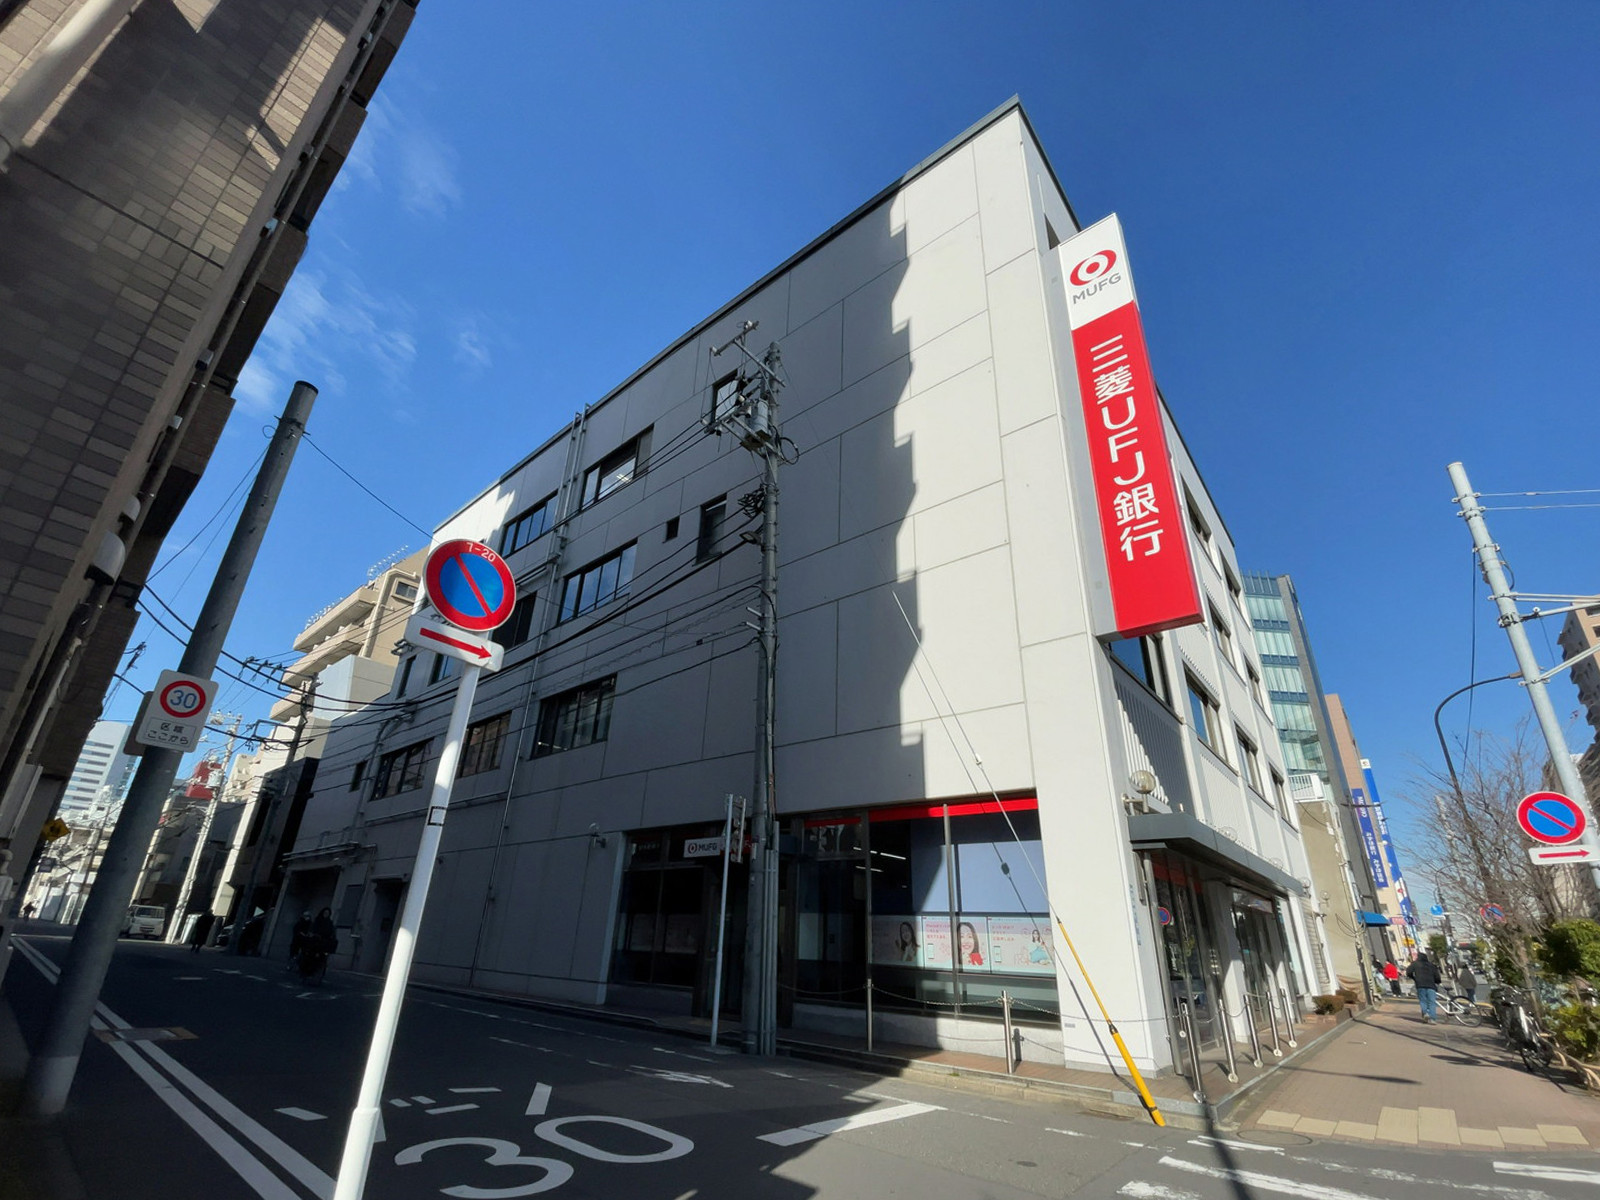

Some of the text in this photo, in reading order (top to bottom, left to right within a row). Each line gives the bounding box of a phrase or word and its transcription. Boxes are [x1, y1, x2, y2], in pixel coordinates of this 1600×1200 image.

[1072, 273, 1122, 304] MUFG
[1089, 333, 1164, 562] 三菱UFJ銀行
[466, 541, 497, 563] 7-20
[170, 689, 197, 709] 30
[147, 730, 189, 745] ここから
[698, 842, 718, 852] MUFG
[394, 1114, 695, 1199] 30
